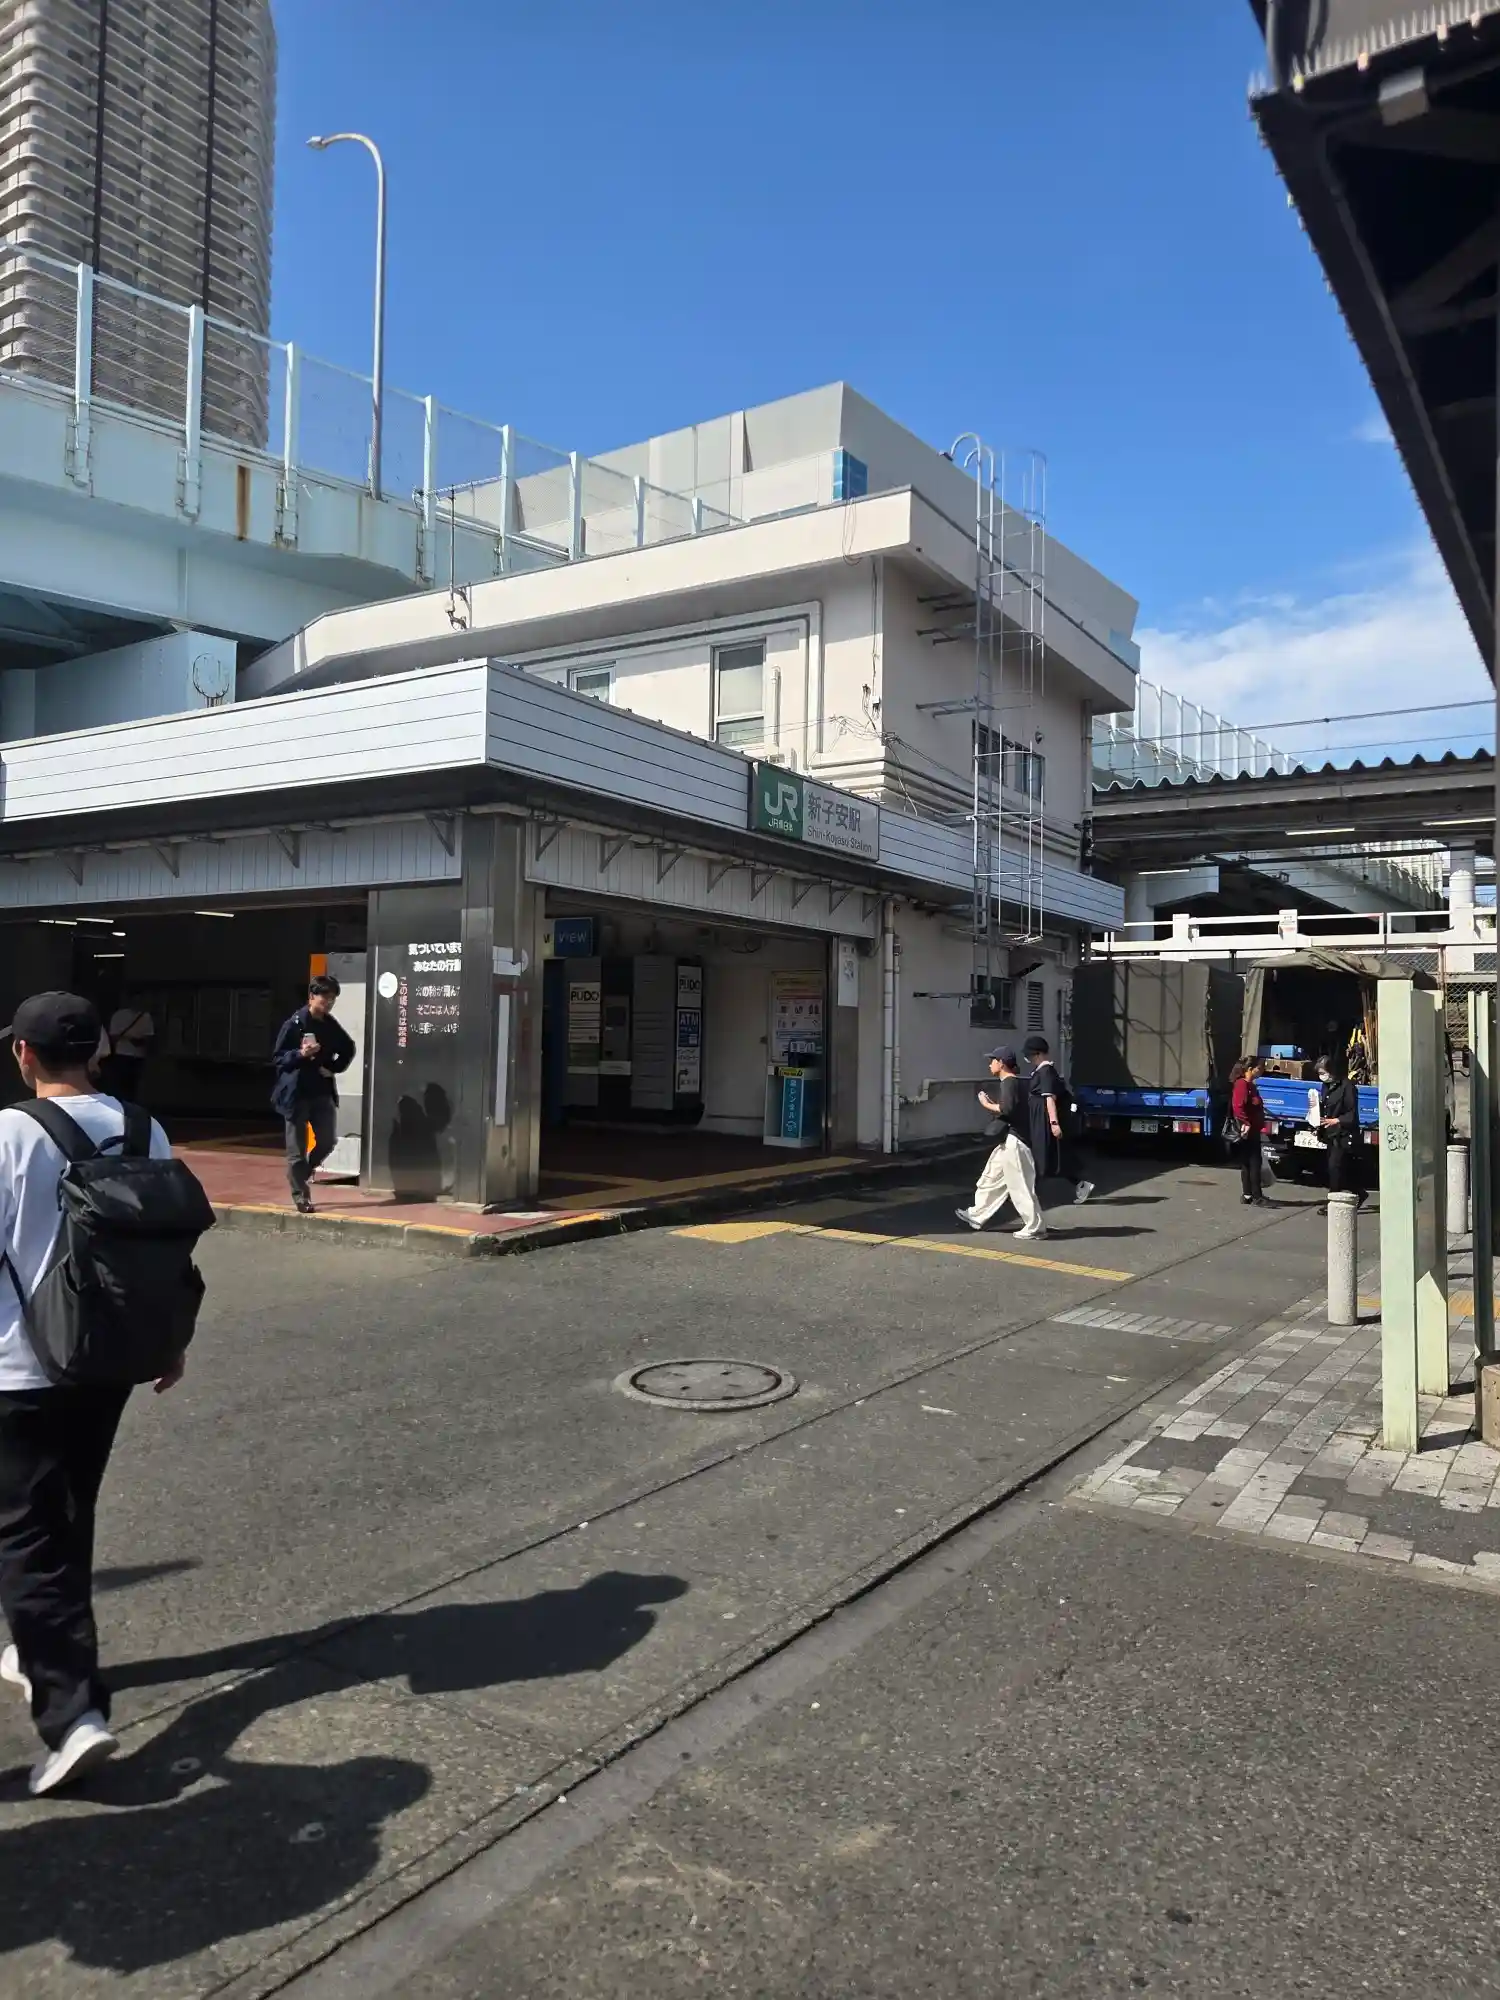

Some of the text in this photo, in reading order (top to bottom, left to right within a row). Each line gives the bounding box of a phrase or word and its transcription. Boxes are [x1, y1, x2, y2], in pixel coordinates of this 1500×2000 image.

[764, 780, 799, 821] JR
[807, 826, 872, 853] Shin-Koyasu Station
[570, 990, 600, 1002] PUDO
[680, 1013, 699, 1026] ATM
